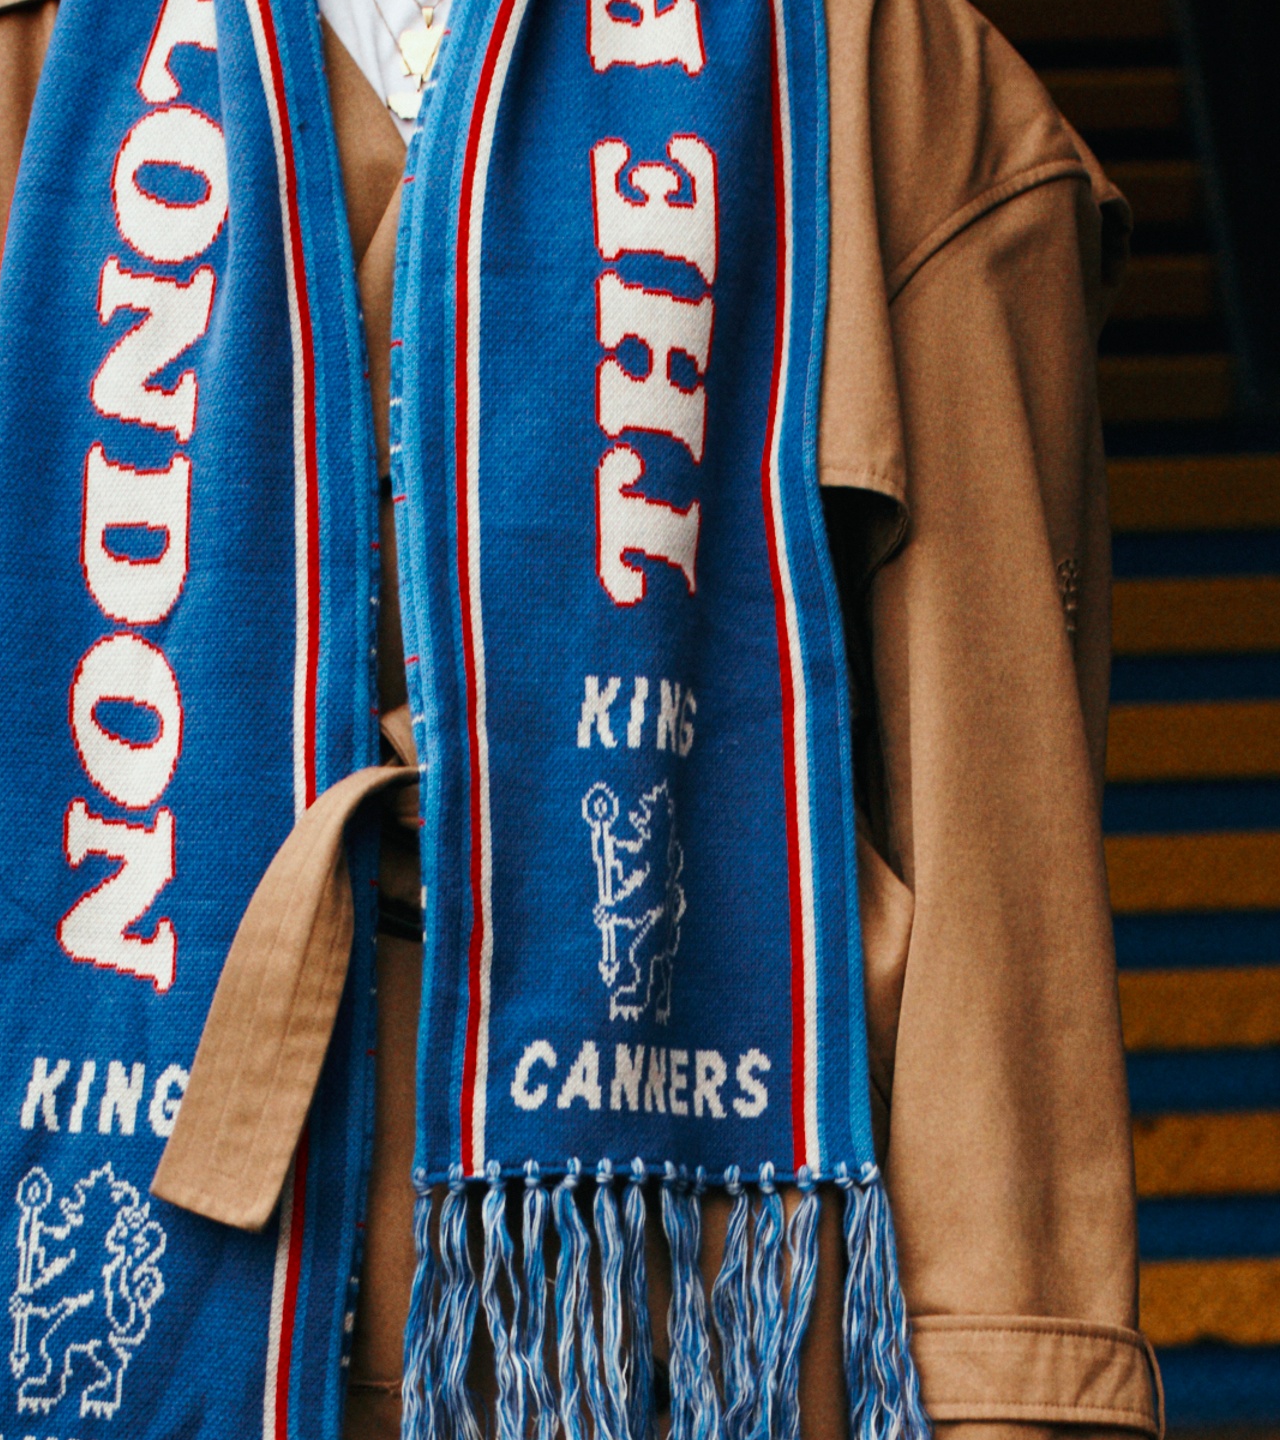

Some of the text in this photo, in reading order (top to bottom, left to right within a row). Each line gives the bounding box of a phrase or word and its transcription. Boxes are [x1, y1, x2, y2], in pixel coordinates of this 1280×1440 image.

[590, 131, 720, 607] THE
[577, 674, 697, 757] KING
[19, 1056, 192, 1138] KING
[509, 1040, 772, 1118] CANNERS
